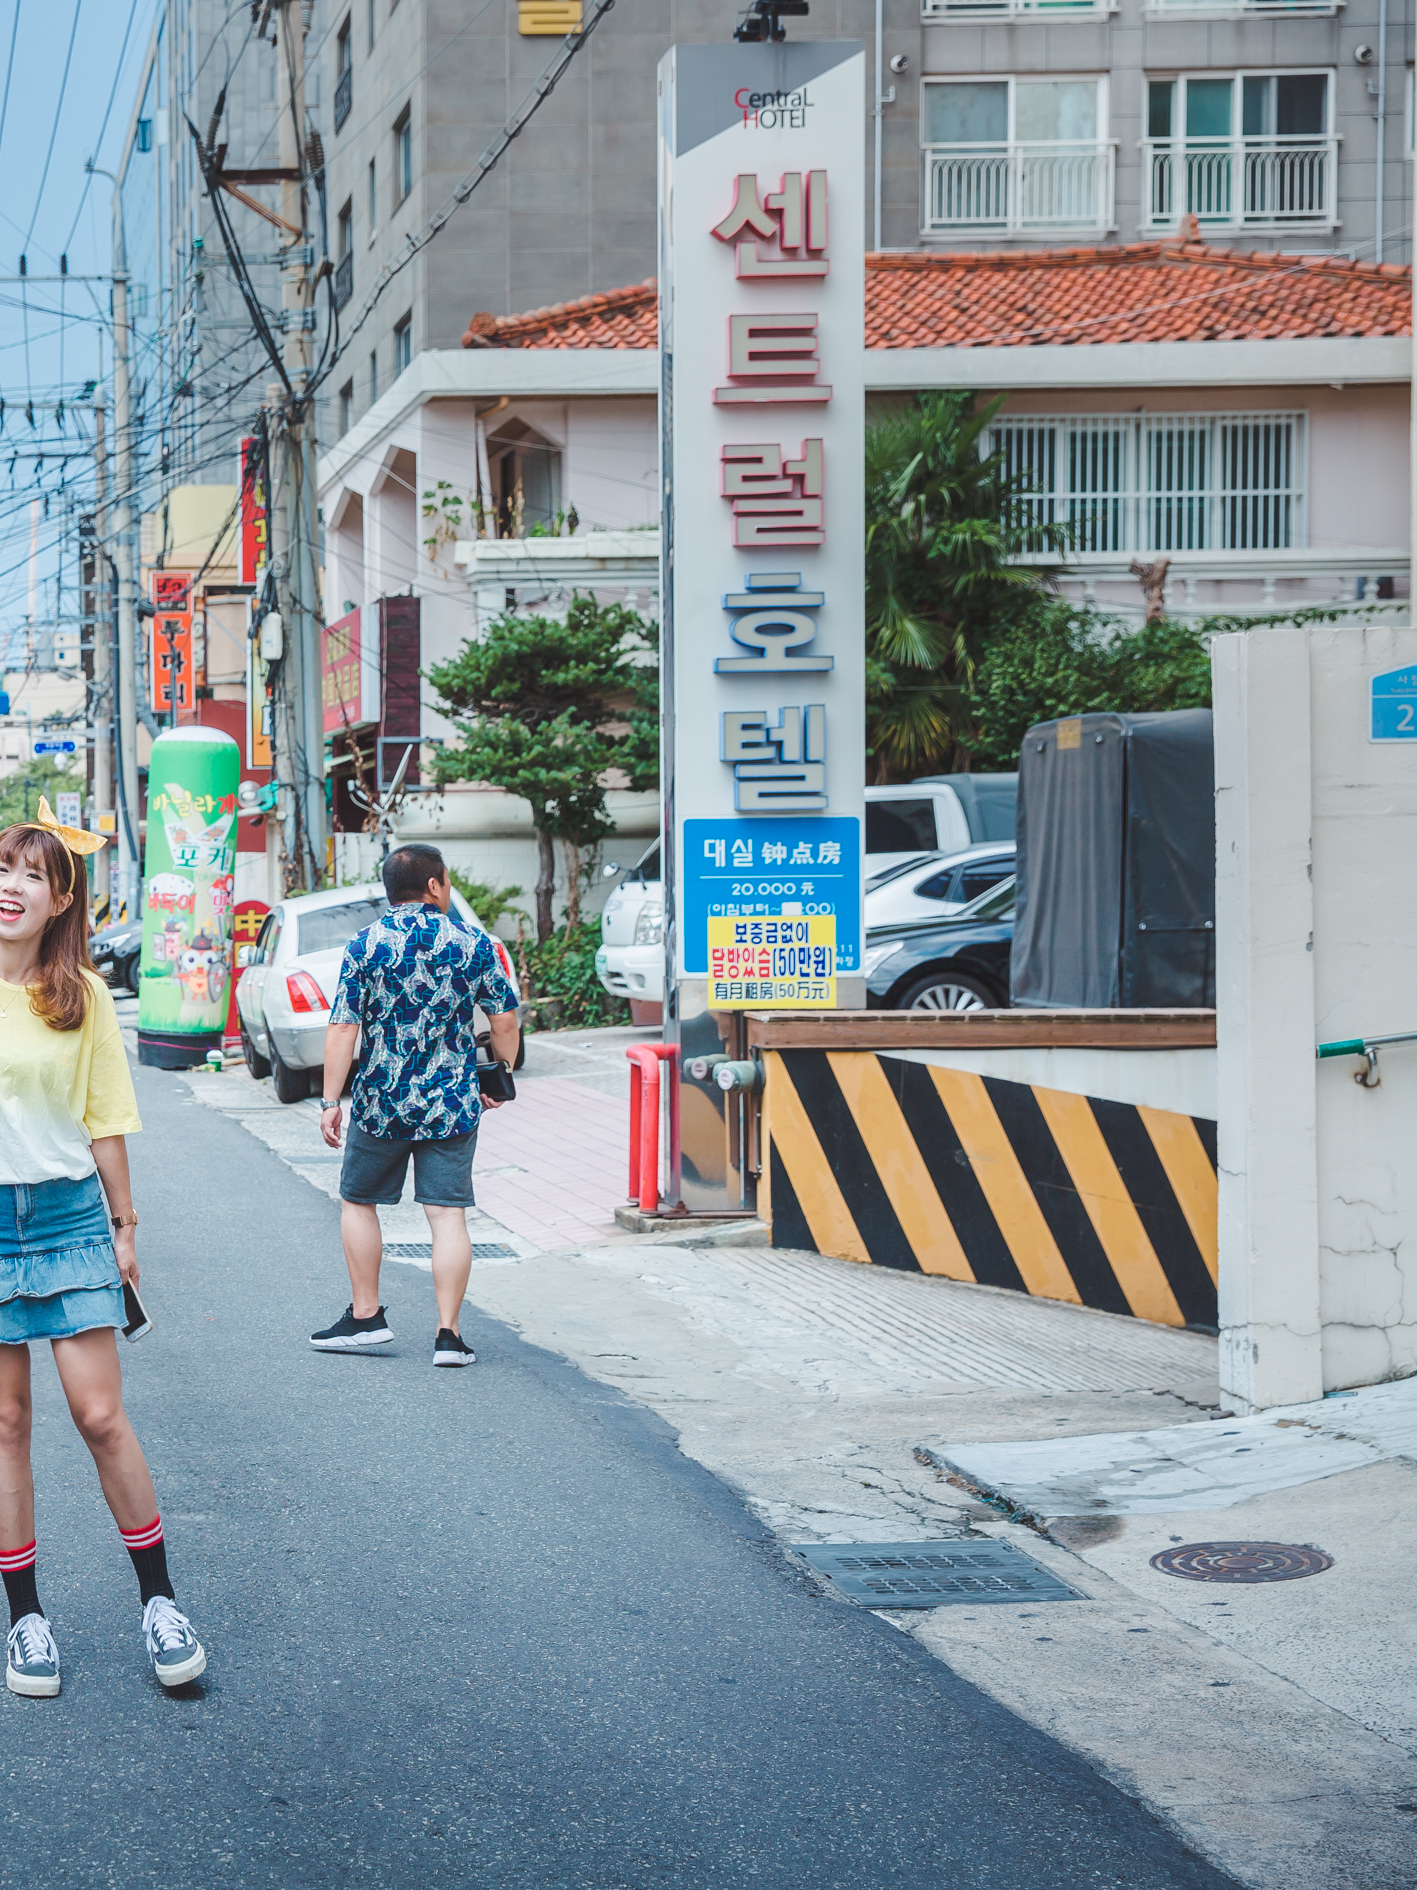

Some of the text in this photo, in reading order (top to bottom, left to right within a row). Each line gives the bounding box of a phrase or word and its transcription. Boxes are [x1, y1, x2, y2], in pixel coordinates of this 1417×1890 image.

[710, 168, 835, 813] 센트럴호텔
[176, 845, 227, 871] 포커
[703, 839, 842, 868] 대실 钟点房
[731, 881, 815, 896] 20.000 元
[148, 893, 196, 915] 바둑이
[735, 922, 809, 945] 보증금없이
